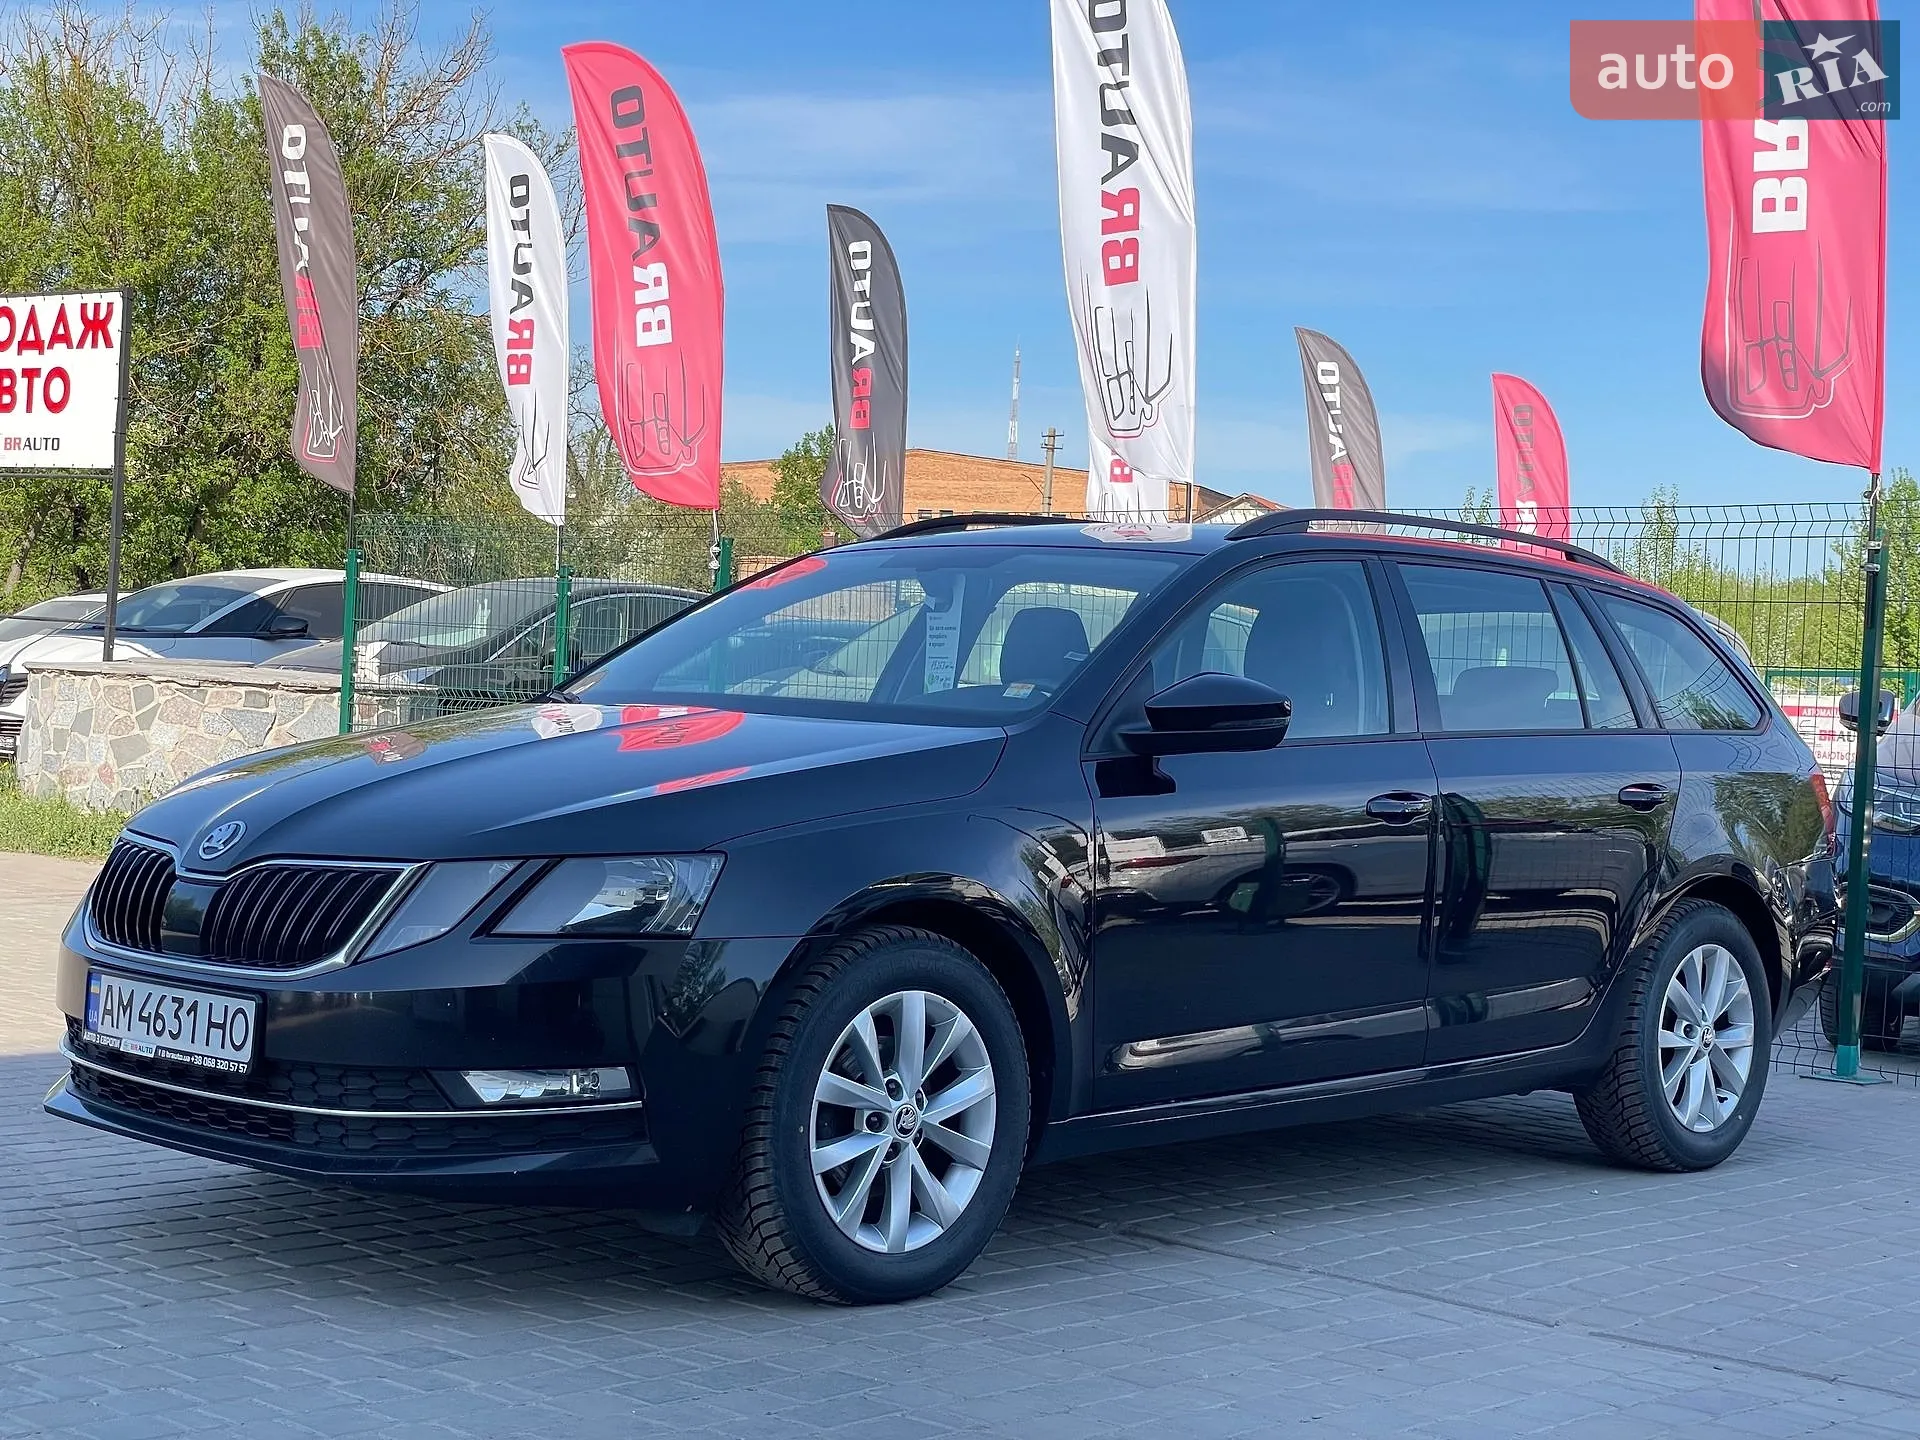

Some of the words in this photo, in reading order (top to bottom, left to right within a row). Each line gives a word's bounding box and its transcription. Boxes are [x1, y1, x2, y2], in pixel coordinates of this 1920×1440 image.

[4, 437, 60, 451] BRAUTO
[89, 1009, 98, 1024] UA
[101, 985, 135, 1032] AM
[138, 991, 199, 1044] 4631
[205, 1002, 249, 1052] HO
